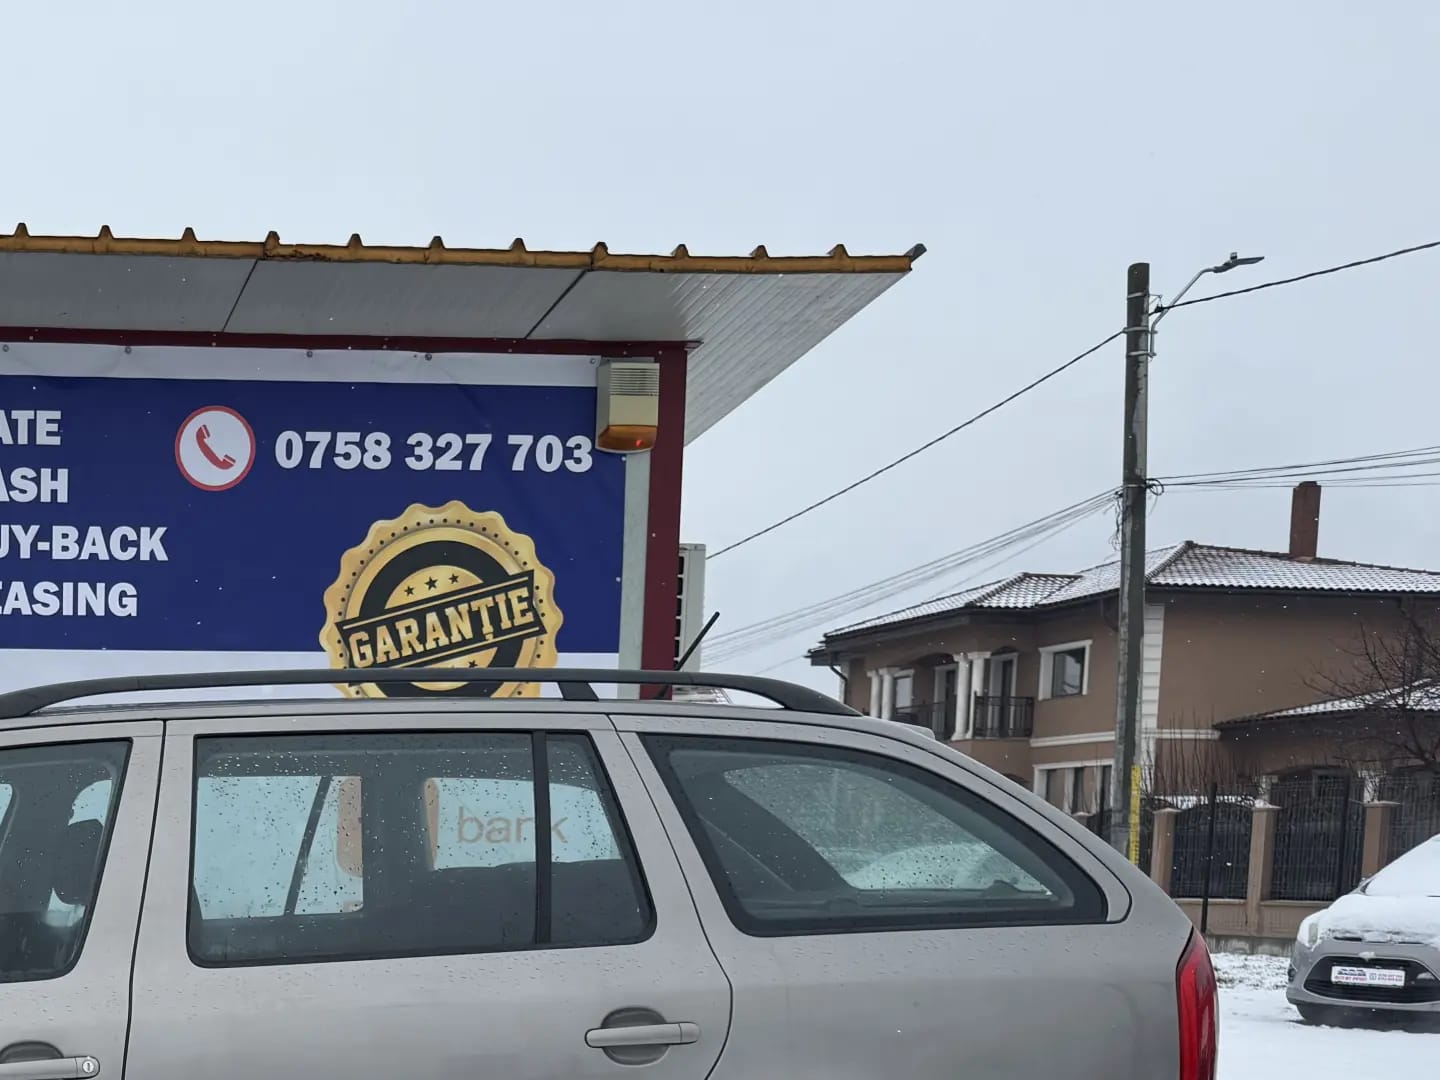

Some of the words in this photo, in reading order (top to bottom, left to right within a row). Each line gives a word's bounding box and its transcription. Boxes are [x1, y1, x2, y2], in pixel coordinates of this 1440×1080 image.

[275, 430, 392, 470] 0758
[405, 432, 492, 471] 327
[508, 435, 593, 473] 703
[347, 586, 535, 668] GARANȚIE
